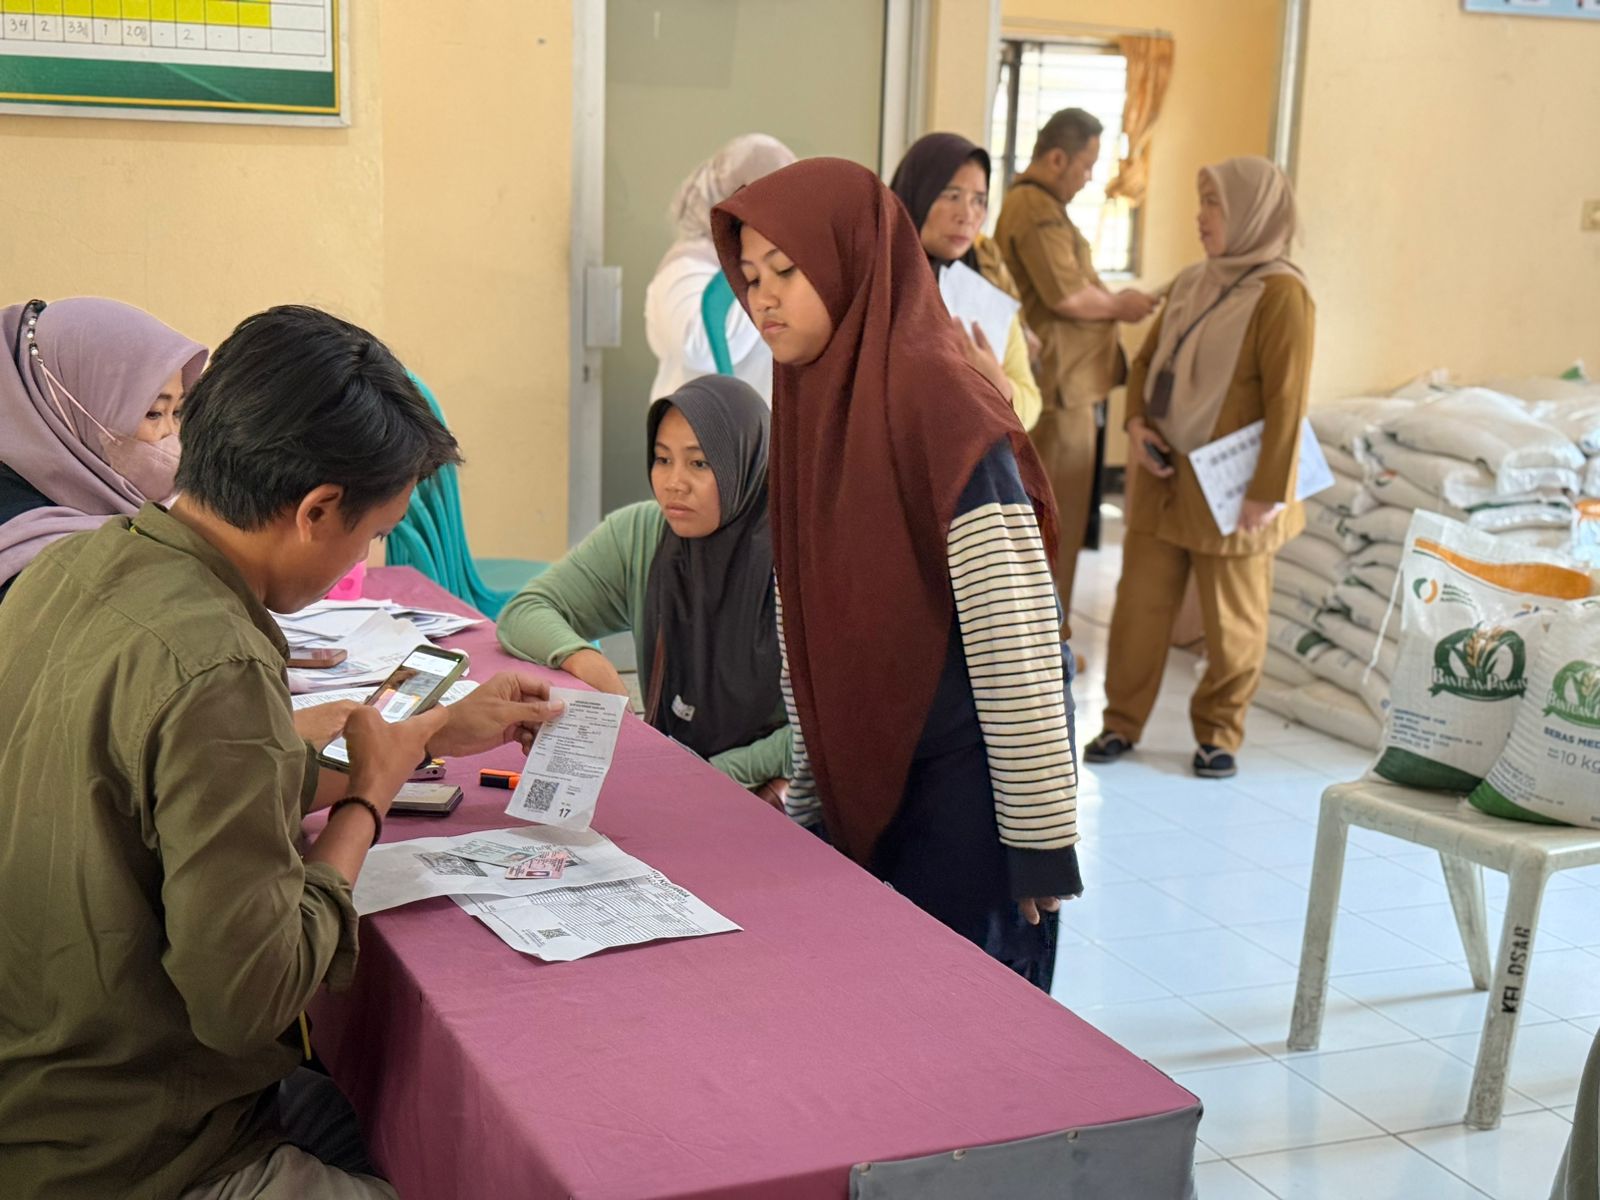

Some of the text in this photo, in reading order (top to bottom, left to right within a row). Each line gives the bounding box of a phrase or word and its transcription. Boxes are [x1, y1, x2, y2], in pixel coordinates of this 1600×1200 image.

[9, 17, 28, 33] 34
[40, 20, 51, 32] 2
[183, 28, 195, 41] 2
[1544, 726, 1575, 744] BERAS
[559, 807, 571, 818] 17
